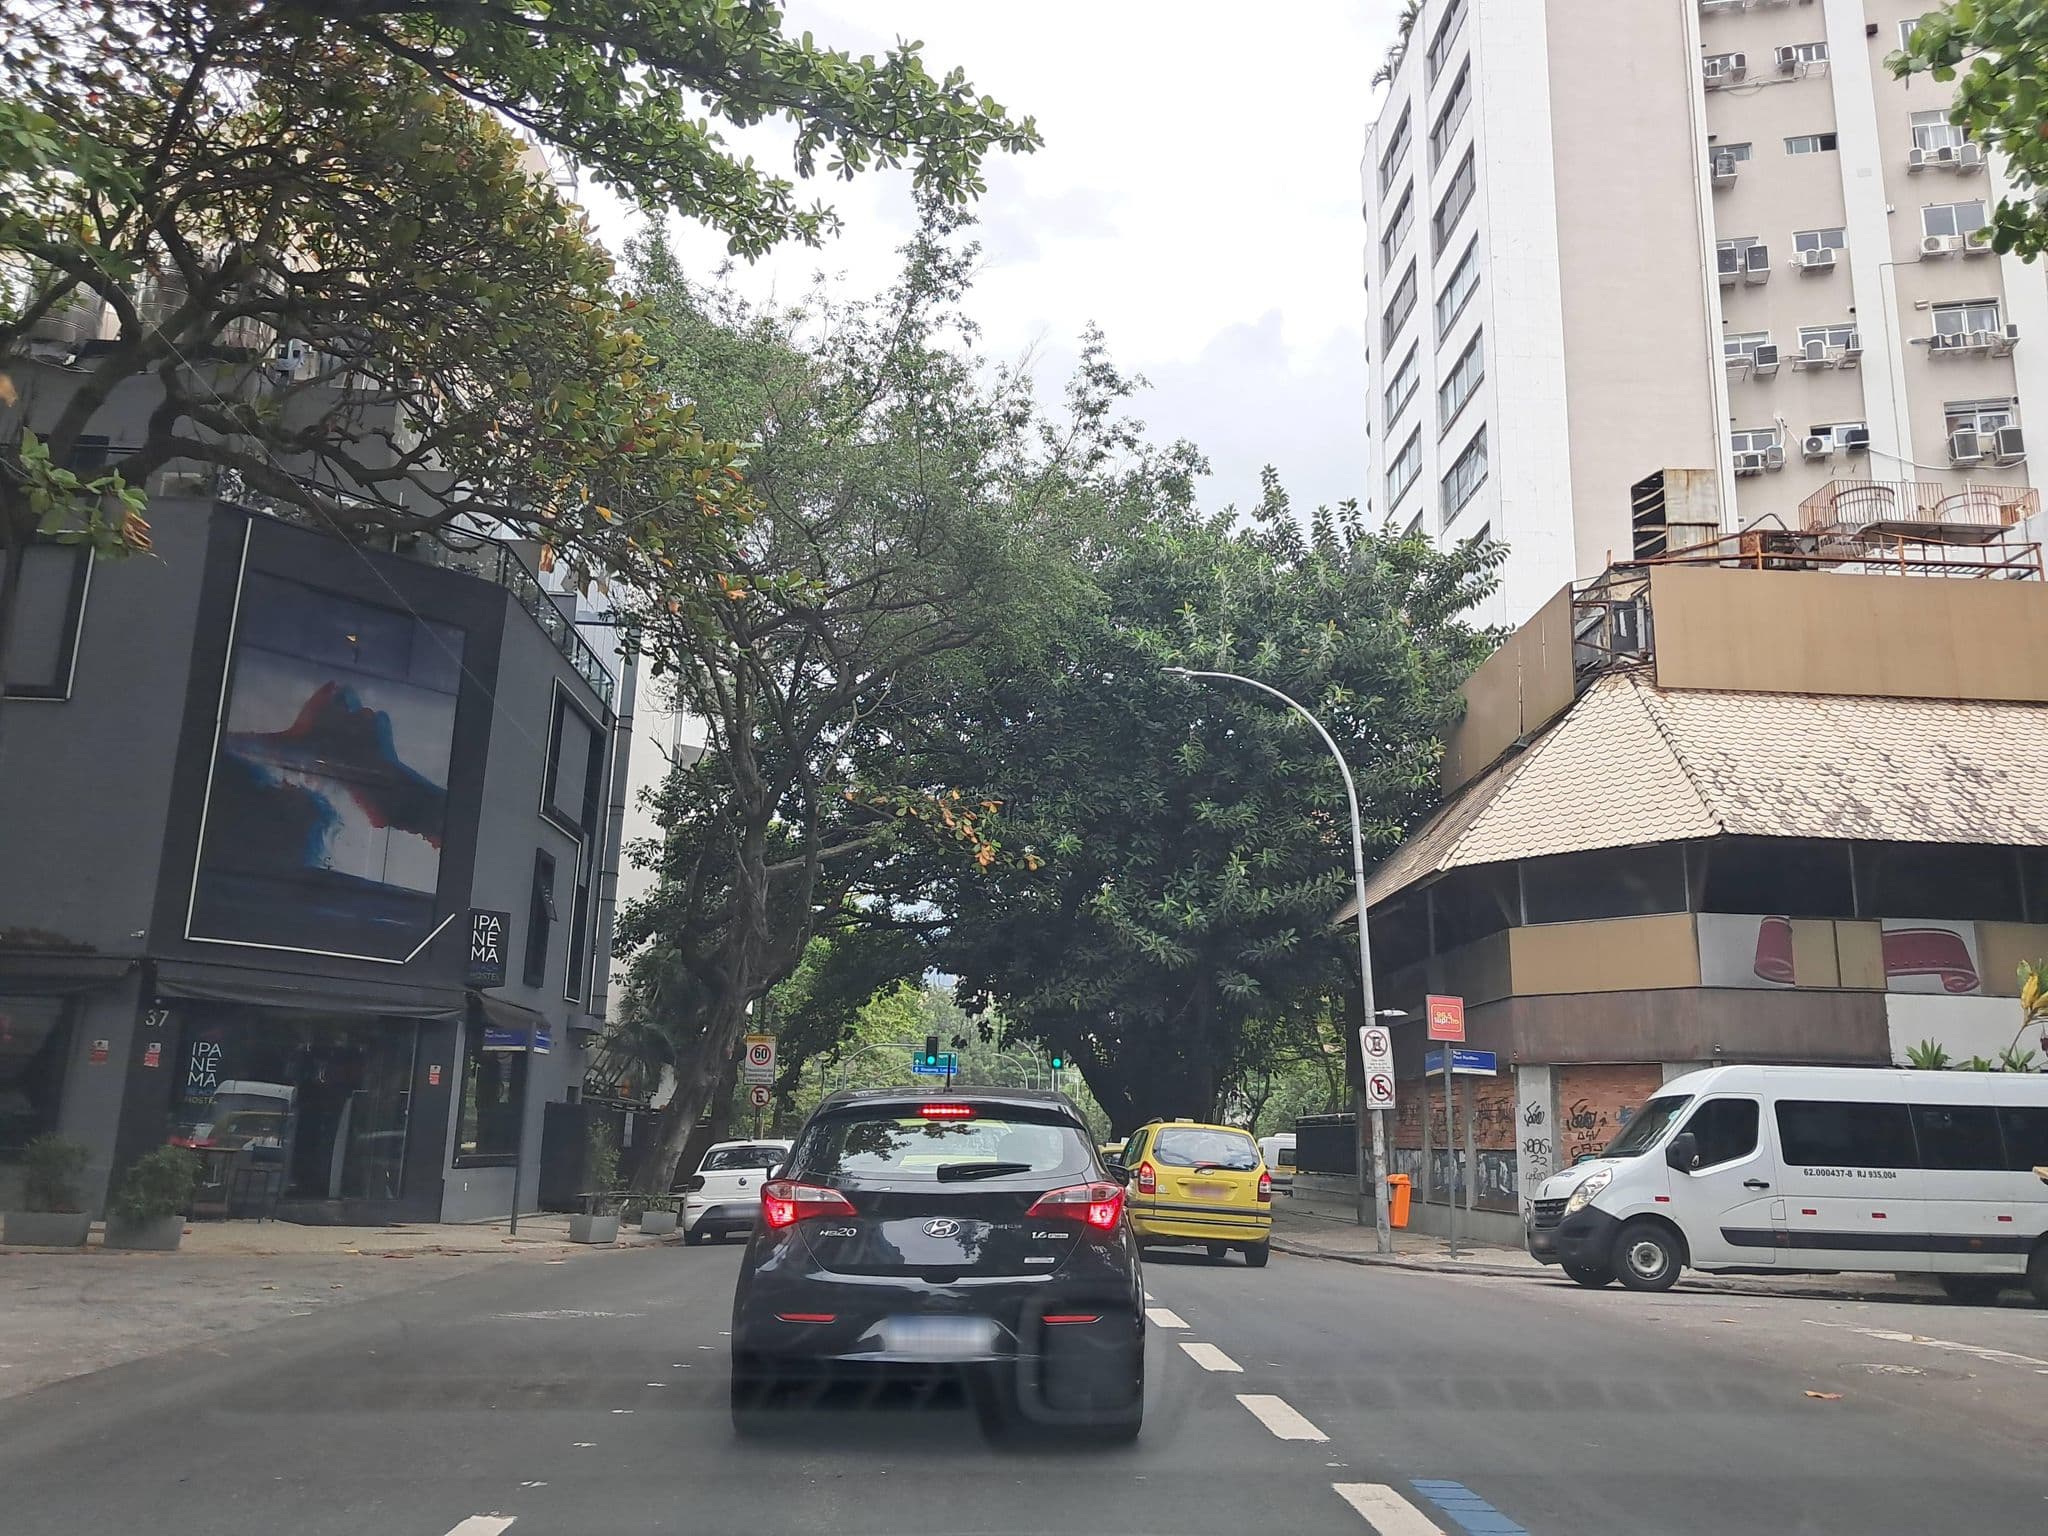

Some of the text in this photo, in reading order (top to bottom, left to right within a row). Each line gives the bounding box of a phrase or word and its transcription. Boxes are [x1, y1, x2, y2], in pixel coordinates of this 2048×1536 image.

[473, 914, 502, 932] IPA
[472, 930, 499, 948] NE
[470, 946, 499, 963] MA
[145, 1009, 169, 1027] 37
[192, 1041, 222, 1057] IPA
[754, 1047, 768, 1059] 60
[190, 1056, 219, 1073] NE
[187, 1071, 217, 1088] MA
[1857, 1170, 1867, 1178] RJ
